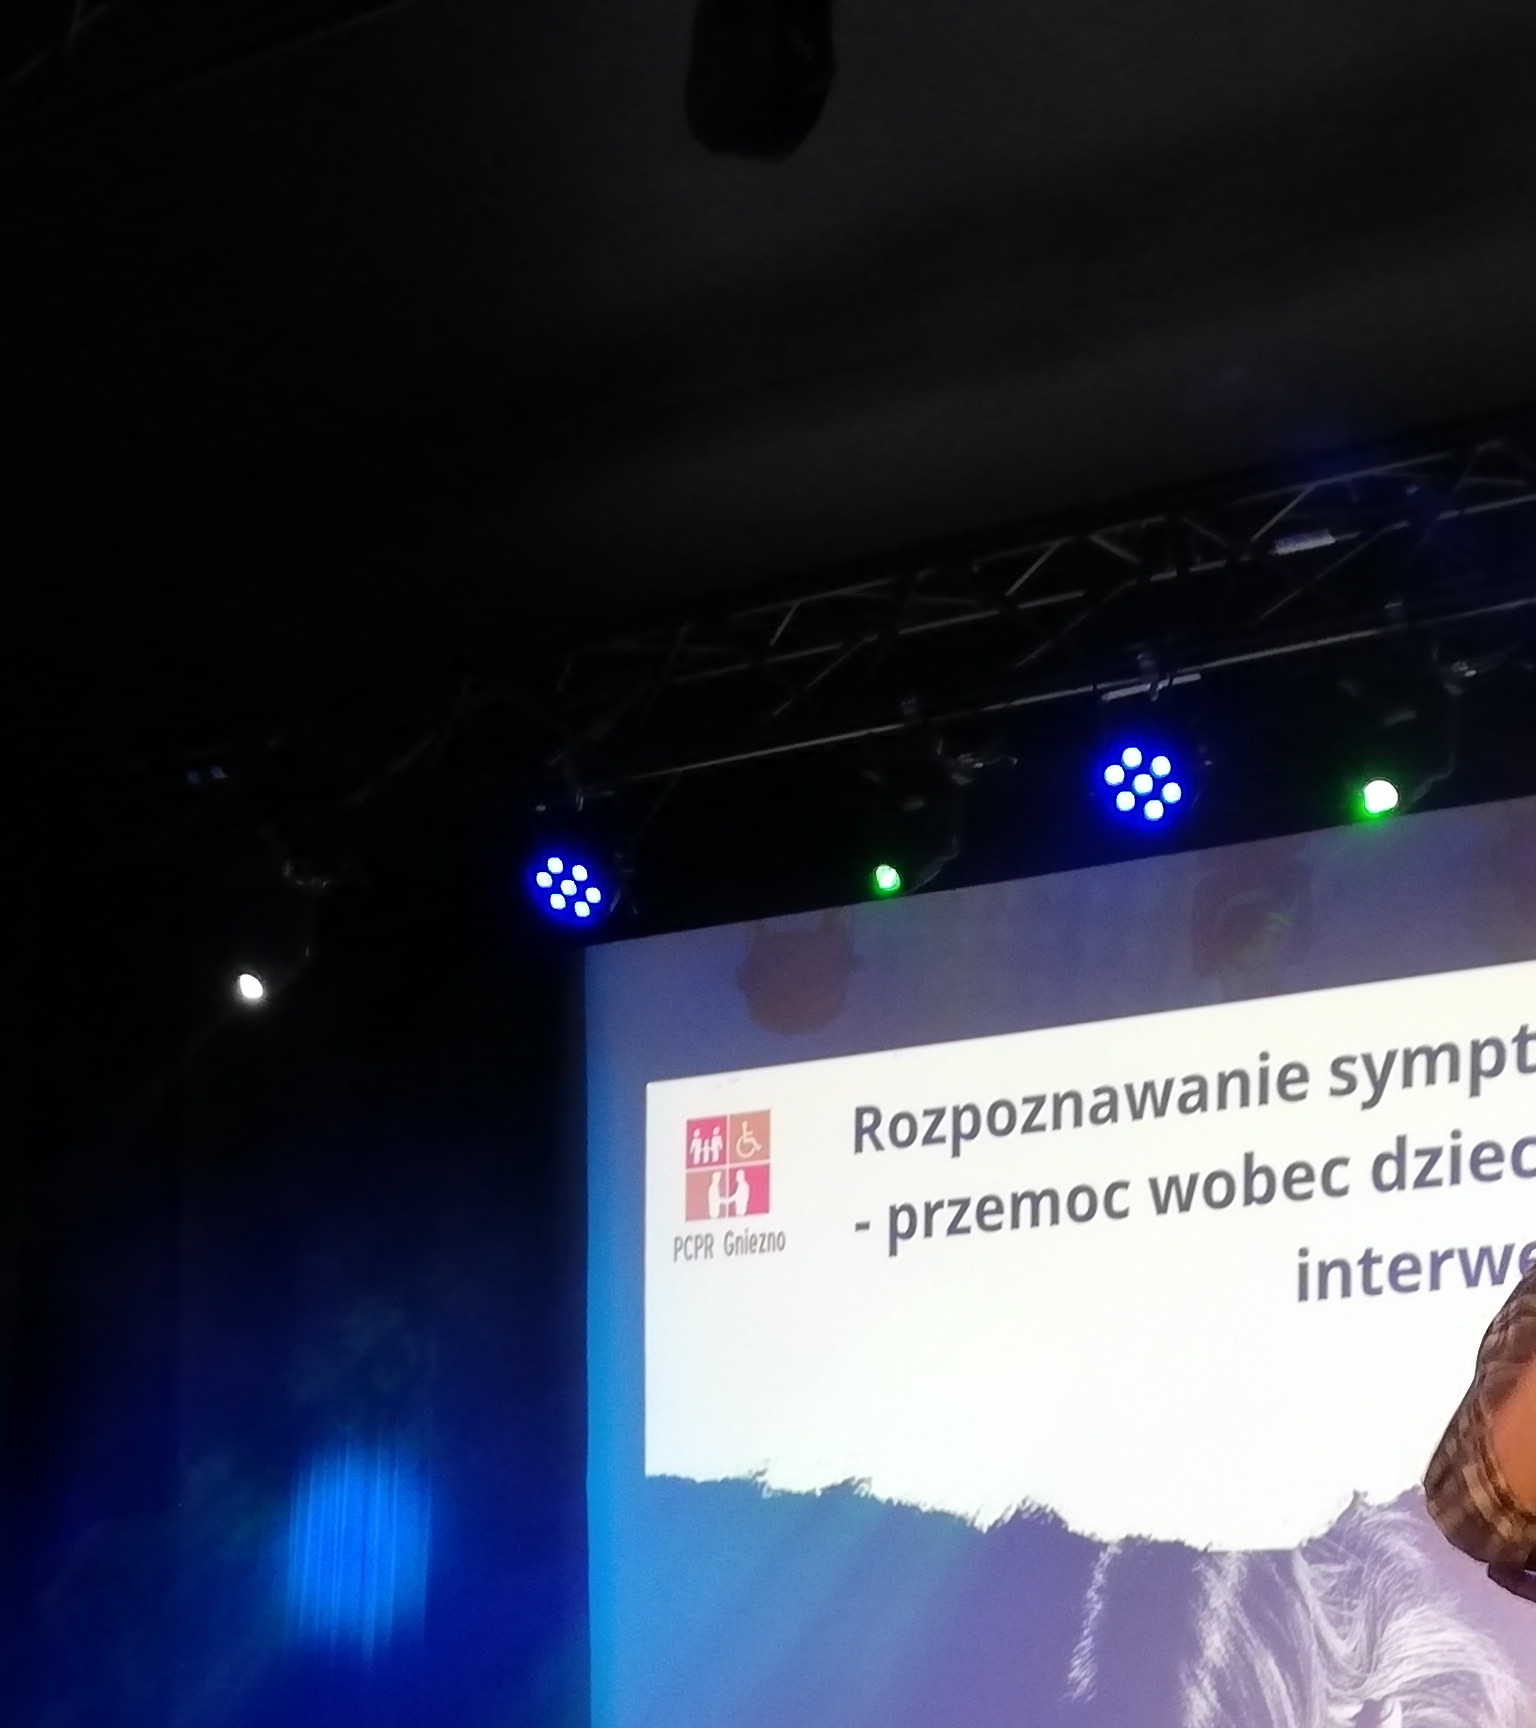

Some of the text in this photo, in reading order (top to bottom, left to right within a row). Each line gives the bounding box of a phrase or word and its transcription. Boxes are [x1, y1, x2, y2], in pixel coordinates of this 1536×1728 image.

[854, 1051, 1310, 1158] Rozpoznawanie
[673, 1227, 786, 1263] PCPR Gniezno
[888, 1180, 1130, 1257] przemoc
[1149, 1151, 1350, 1216] wobec
